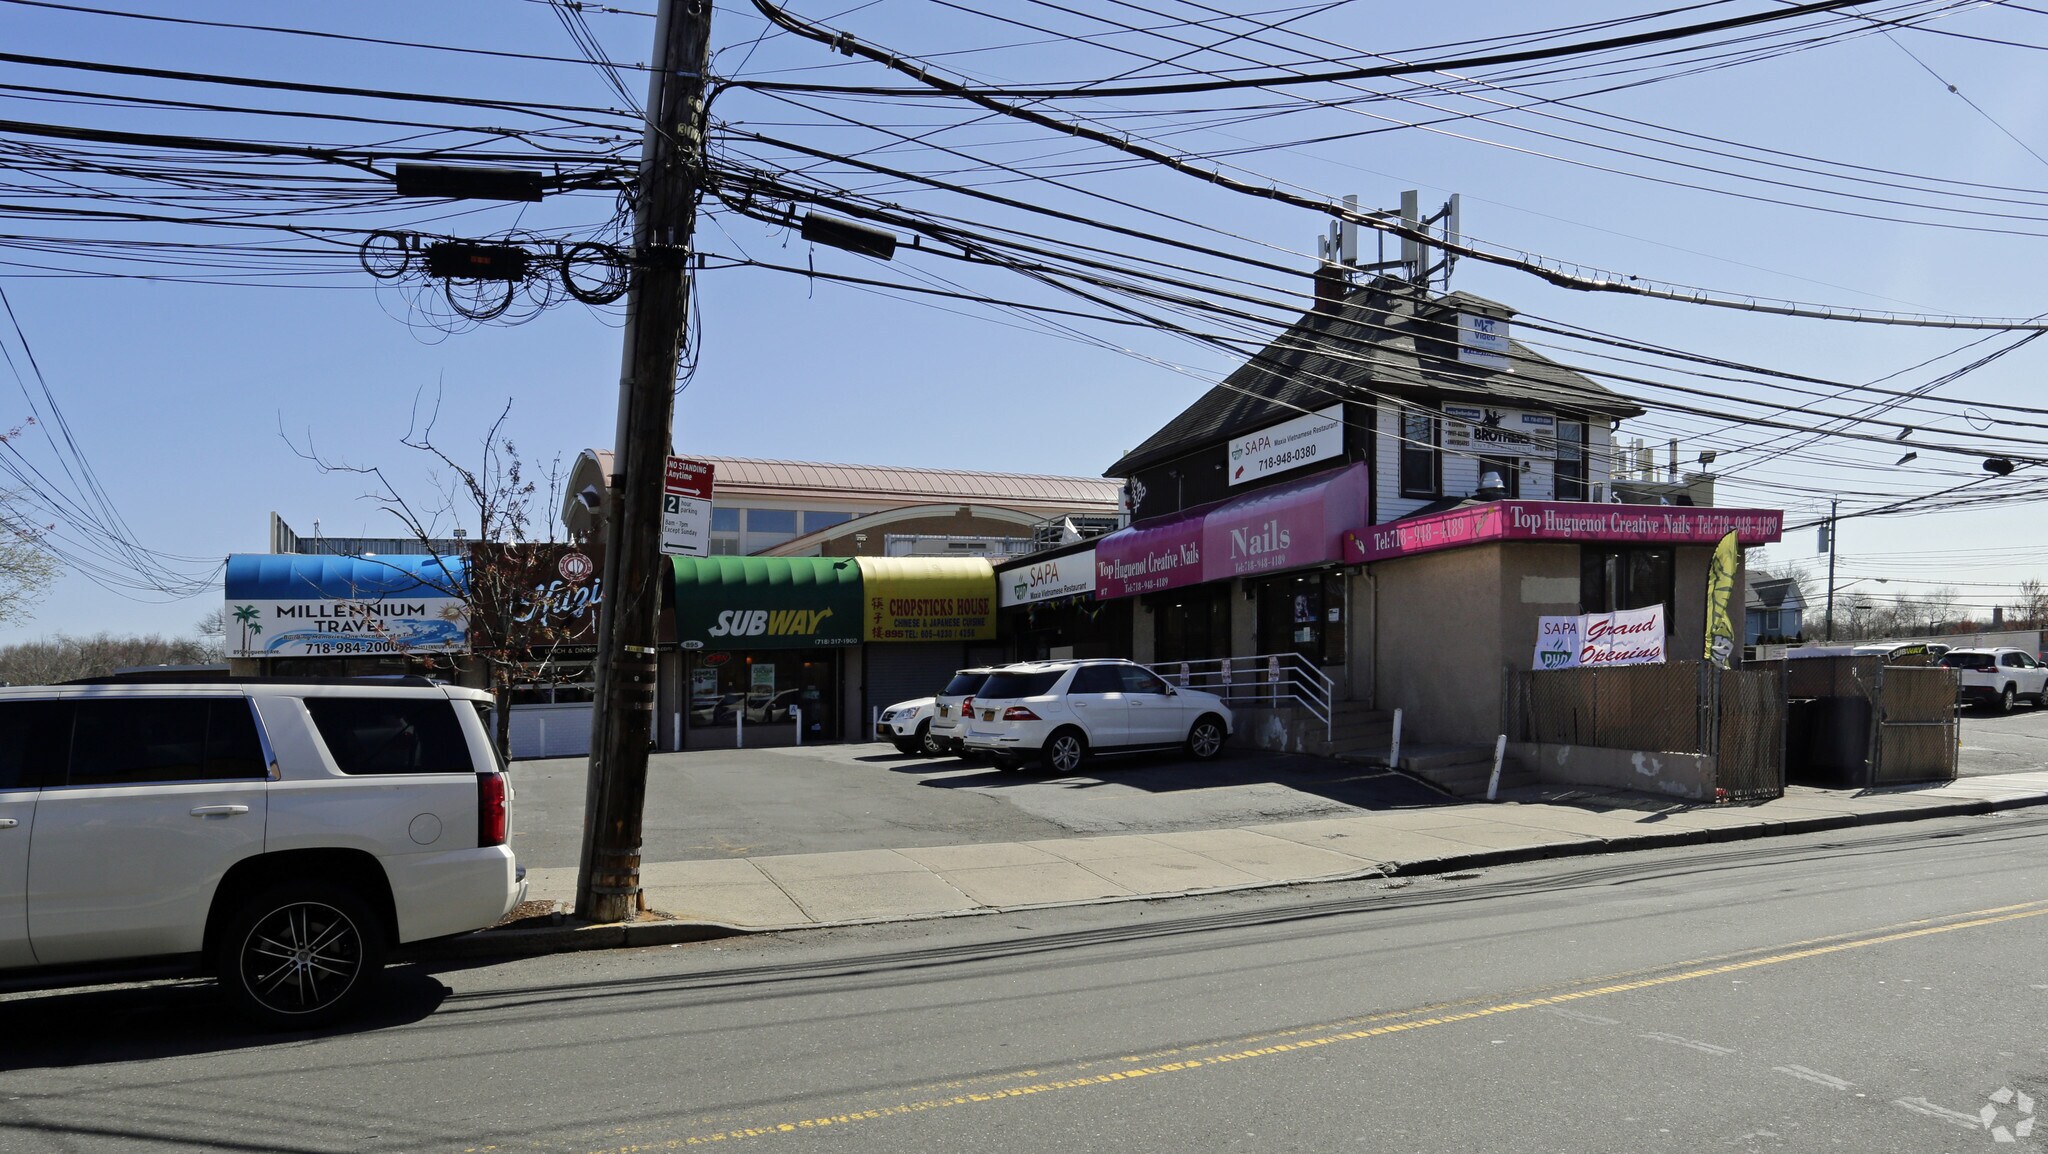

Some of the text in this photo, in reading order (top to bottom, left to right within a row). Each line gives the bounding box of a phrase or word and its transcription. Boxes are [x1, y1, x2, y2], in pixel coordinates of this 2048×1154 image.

[1245, 436, 1270, 456] SAPA
[1287, 429, 1312, 443] Vietnamese
[1313, 421, 1338, 435] Restaurant
[1259, 444, 1316, 471] 718-948-0380
[668, 461, 707, 474] NO STANDING
[668, 470, 692, 481] Anytime
[667, 496, 677, 512] 2
[680, 507, 698, 515] parking
[681, 500, 691, 508] hour
[1511, 506, 1541, 534] Top
[1545, 509, 1606, 537] Huguenot
[1610, 512, 1658, 535] Creative
[1663, 514, 1691, 534] Nails
[665, 526, 697, 536] Except Sunday
[1374, 517, 1464, 551] Tel:718-948-4189
[1230, 520, 1291, 560] Nails
[1098, 541, 1199, 584] Top Huguenot Creative Nails
[1030, 562, 1059, 587] SAPA
[1042, 587, 1063, 599] Vietnamese
[1064, 582, 1087, 593] Restaurant
[276, 604, 425, 618] MILLENNIUM
[889, 597, 990, 617] CHOPSTICKS HOUSE
[314, 620, 390, 632] TRAVEL
[708, 607, 833, 637] SUBWAY
[894, 618, 920, 628] CHINESE
[929, 617, 960, 627] JAPANESE
[962, 617, 986, 627] CUISINE
[1544, 614, 1656, 642] SAPA Grand
[884, 629, 904, 638] 895
[1579, 645, 1662, 664] Opening
[1890, 646, 1928, 660] SUBWAY
